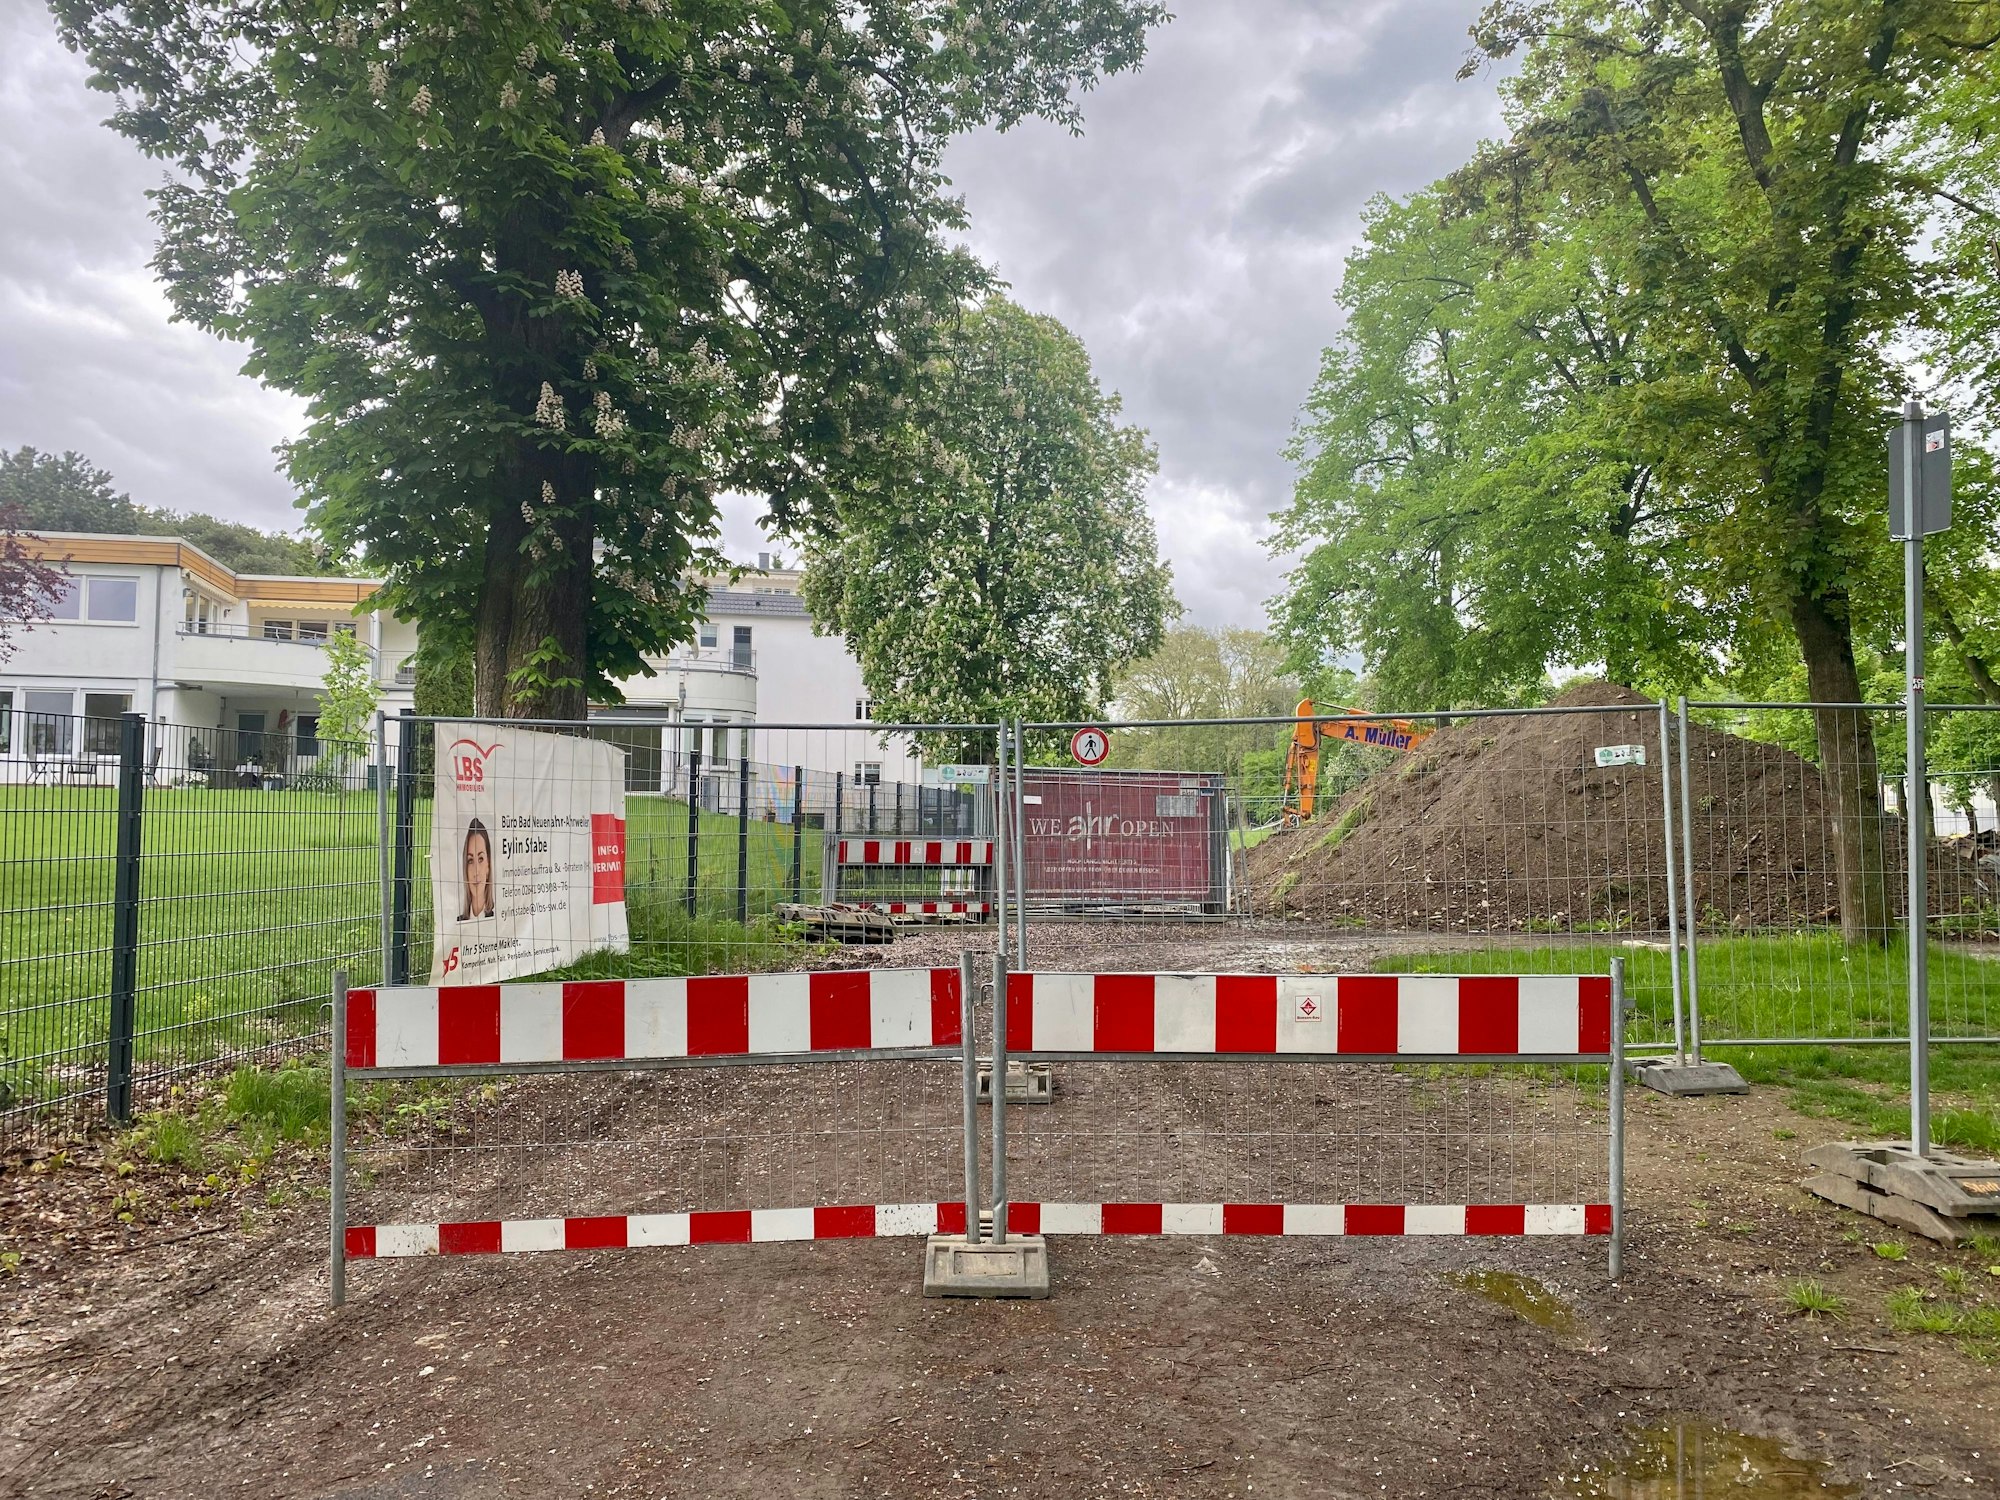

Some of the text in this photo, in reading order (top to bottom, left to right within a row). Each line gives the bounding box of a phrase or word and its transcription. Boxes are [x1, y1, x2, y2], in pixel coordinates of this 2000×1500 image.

[1344, 726, 1412, 749] A. Müller
[454, 756, 483, 782] LBS
[501, 814, 590, 829] Büro Bad Neuenahr-Ahrweiler
[1029, 818, 1061, 835] WE
[1121, 820, 1174, 837] OPEN
[502, 836, 548, 859] Eylin Stabe
[597, 845, 619, 856] INFO
[554, 862, 562, 873] &
[502, 885, 521, 898] Telefon
[462, 937, 521, 956] Ihr 5 Sterne Makler.
[461, 959, 487, 971] Kompetent.
[507, 951, 533, 961] Persönlich.
